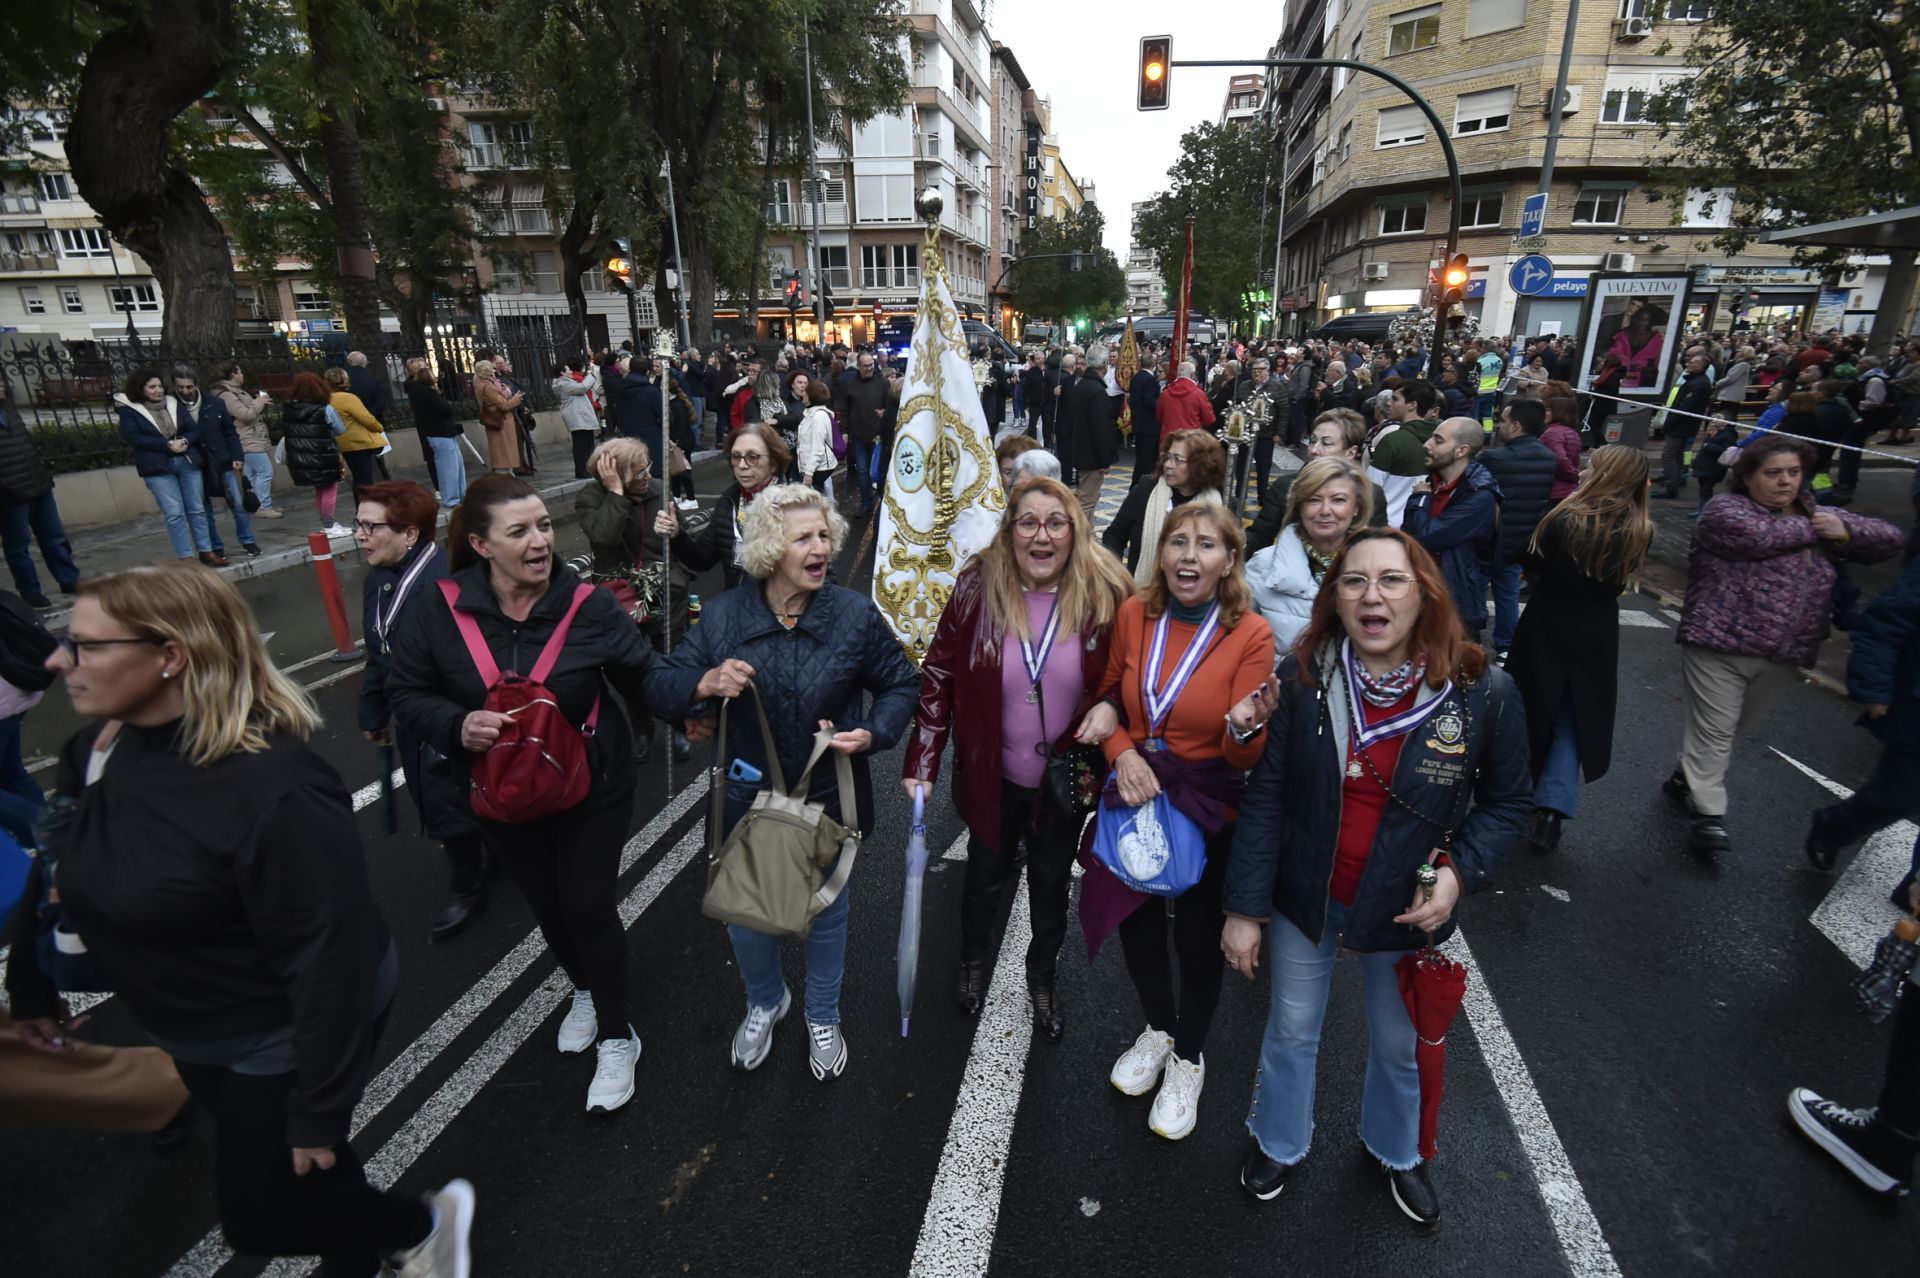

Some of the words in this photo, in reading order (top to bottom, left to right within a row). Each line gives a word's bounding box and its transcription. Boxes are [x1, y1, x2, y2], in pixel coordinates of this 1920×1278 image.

[1028, 156, 1037, 229] HOTE
[1524, 208, 1543, 225] TAXI
[1553, 281, 1588, 293] pelayo
[1607, 281, 1678, 293] VALENTINO
